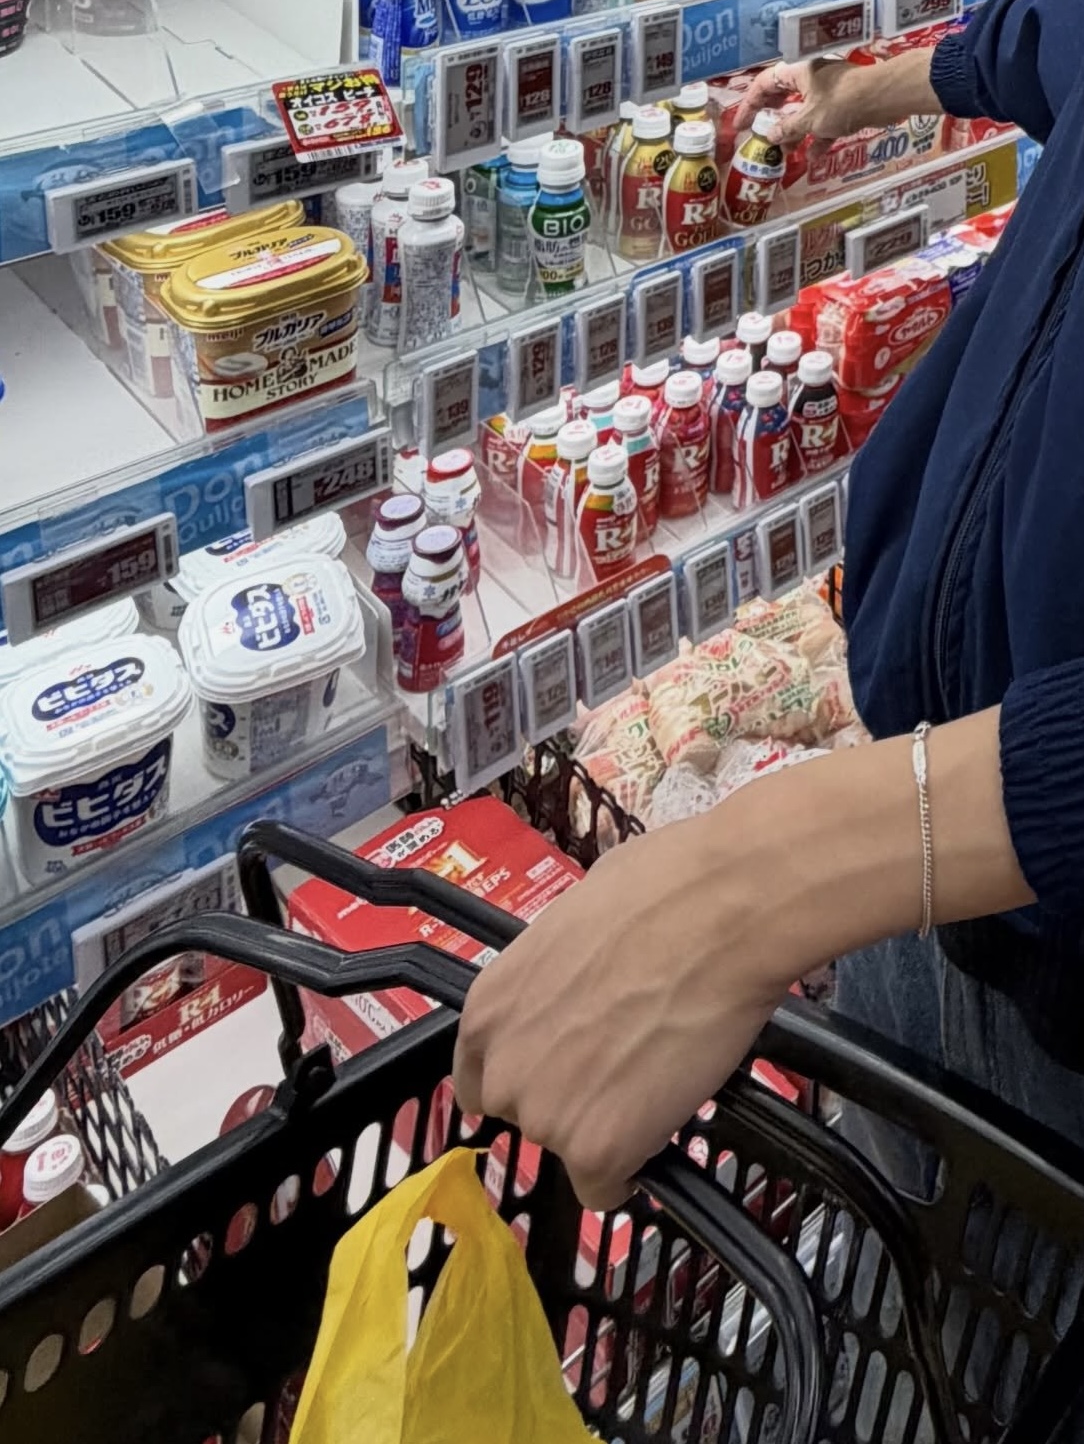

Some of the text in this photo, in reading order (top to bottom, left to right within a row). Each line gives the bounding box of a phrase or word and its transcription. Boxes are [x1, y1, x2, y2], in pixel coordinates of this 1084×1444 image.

[289, 86, 376, 109] オイコス ピーチ
[869, 131, 909, 164] 400
[543, 214, 585, 236] BIO
[254, 313, 325, 348] ブルガリア
[213, 371, 275, 403] HOME
[266, 372, 319, 401] STORY
[106, 551, 158, 584] 159
[36, 663, 142, 712] ビヒダス
[41, 752, 168, 829] ビヒダス
